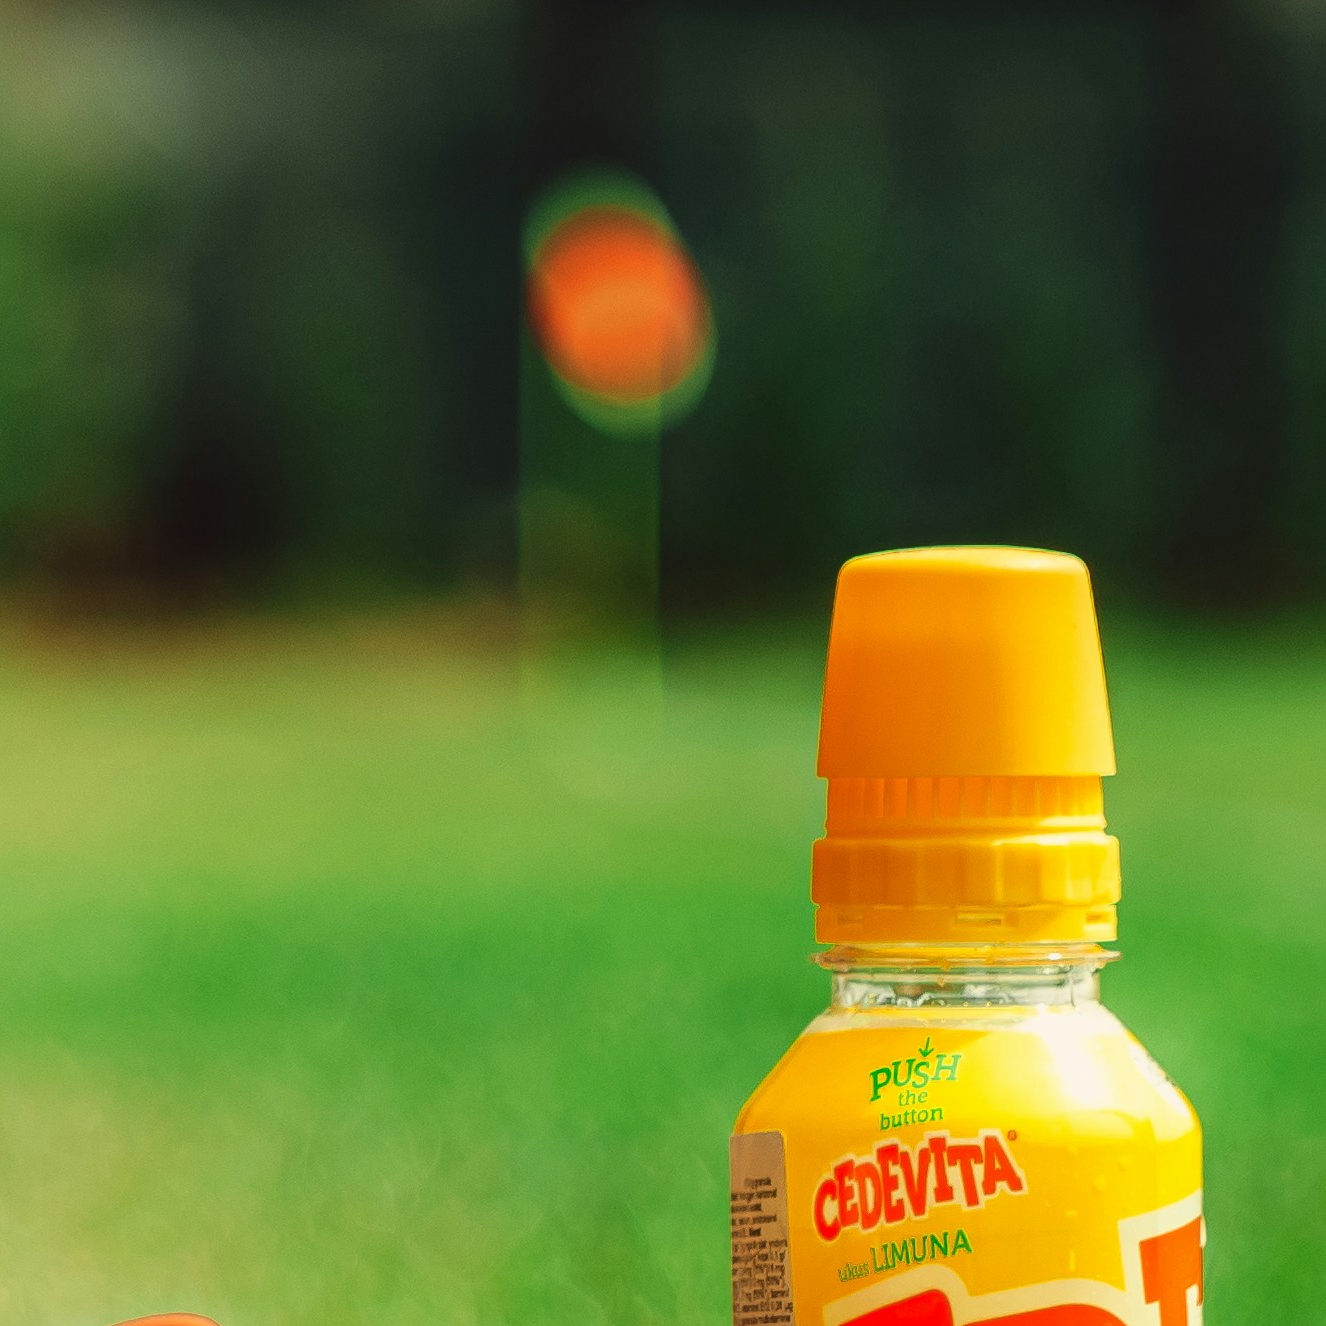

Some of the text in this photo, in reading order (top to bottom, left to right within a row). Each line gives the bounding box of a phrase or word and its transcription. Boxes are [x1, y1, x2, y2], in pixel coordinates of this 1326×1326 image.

[869, 1054, 962, 1102] PUSH
[898, 1090, 928, 1107] the
[880, 1107, 944, 1131] button
[813, 1133, 1024, 1242] CEDEVITA
[870, 1228, 973, 1273] LIMUNA
